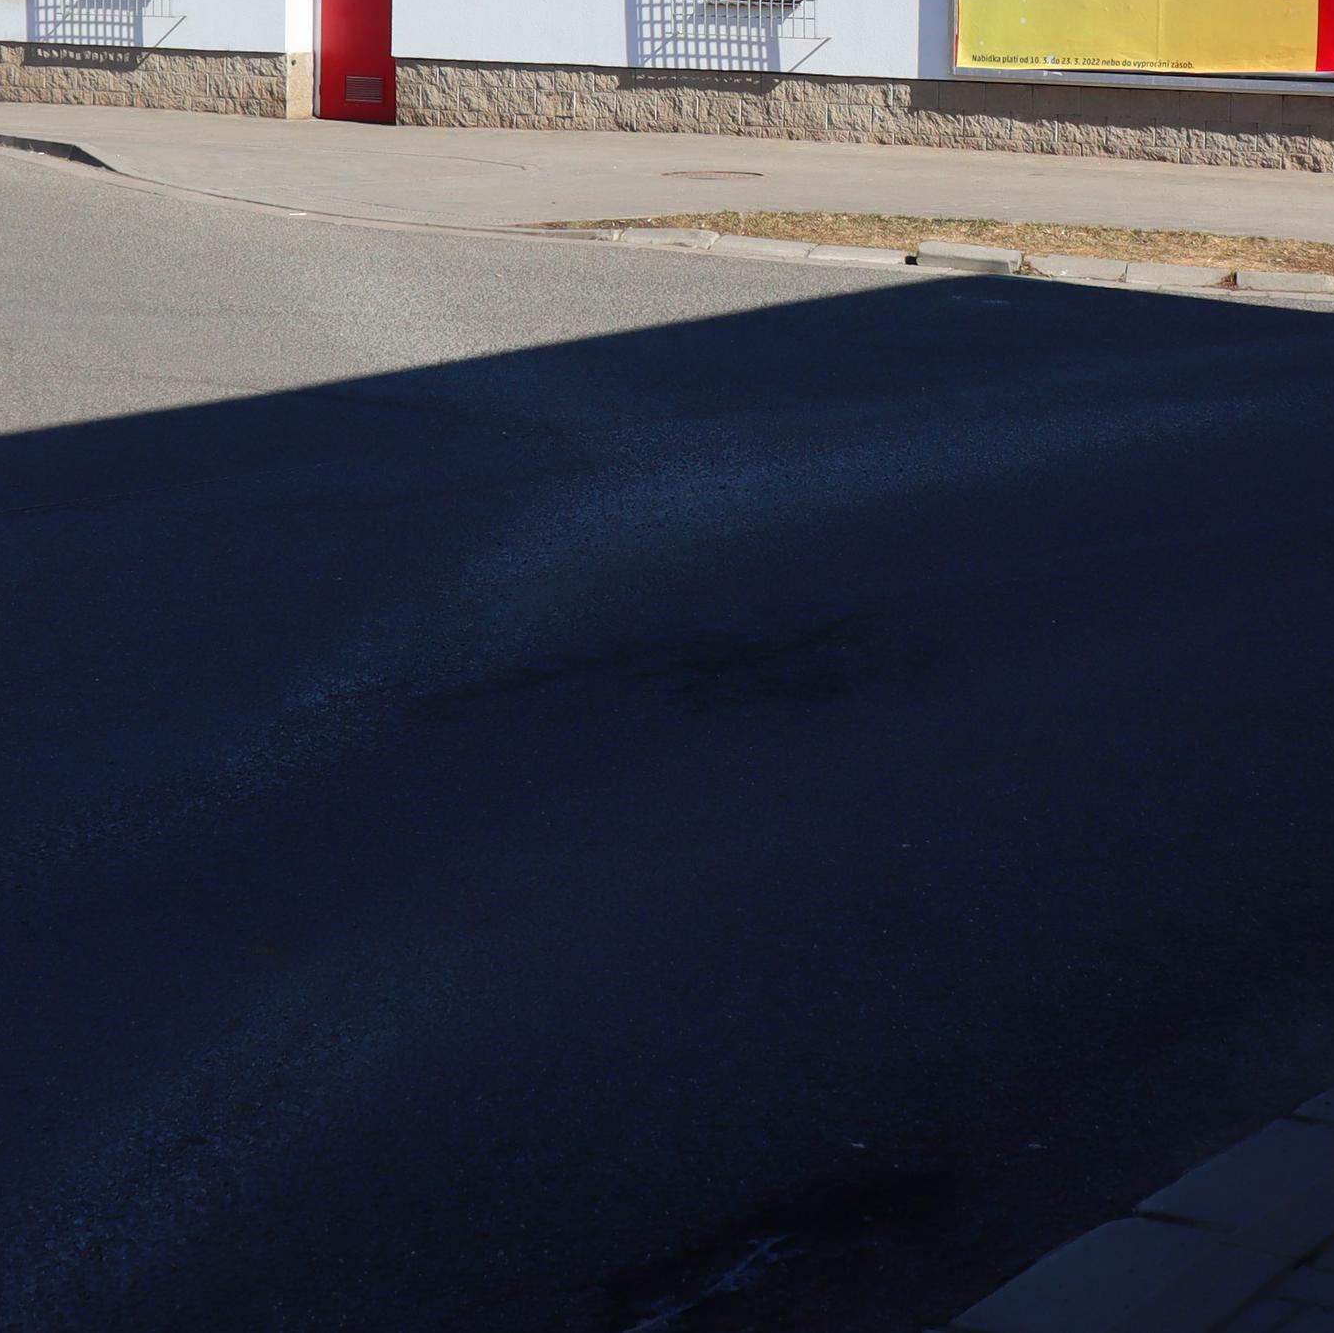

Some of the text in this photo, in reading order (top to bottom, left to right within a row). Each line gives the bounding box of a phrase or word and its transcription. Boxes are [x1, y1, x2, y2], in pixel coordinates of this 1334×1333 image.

[972, 54, 1000, 63] Nabídka
[1019, 55, 1029, 63] od
[1050, 57, 1060, 65] do
[1082, 57, 1100, 66] 2022
[1101, 58, 1121, 67] nebo
[1122, 58, 1132, 67] do
